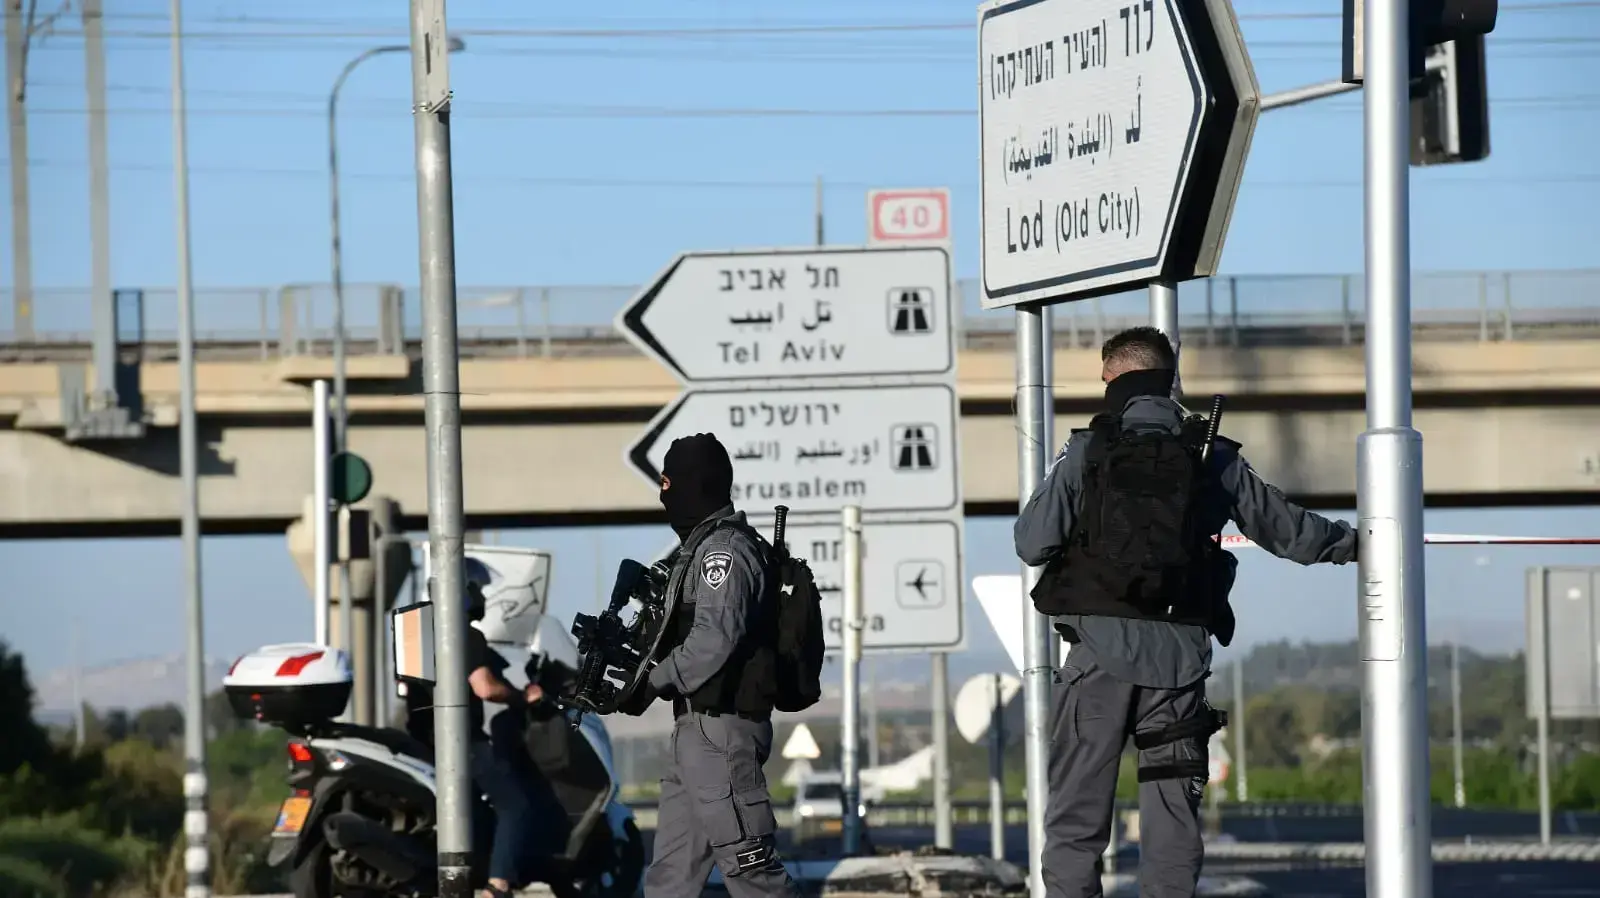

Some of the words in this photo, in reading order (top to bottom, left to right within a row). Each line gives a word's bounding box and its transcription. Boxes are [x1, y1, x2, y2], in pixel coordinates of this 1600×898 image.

[1120, 0, 1153, 56] לוד
[1064, 19, 1107, 74] (העיר
[990, 40, 1054, 100] העתיקה)
[891, 205, 930, 229] 40
[1007, 200, 1043, 254] Lod
[1055, 198, 1089, 253] (Old
[1099, 186, 1140, 241] City)
[718, 268, 787, 292] אביב
[805, 264, 840, 289] תל
[718, 342, 760, 364] Tel
[781, 341, 846, 363] Aviv
[729, 401, 841, 428] ירושלים
[731, 476, 866, 499] erusalem
